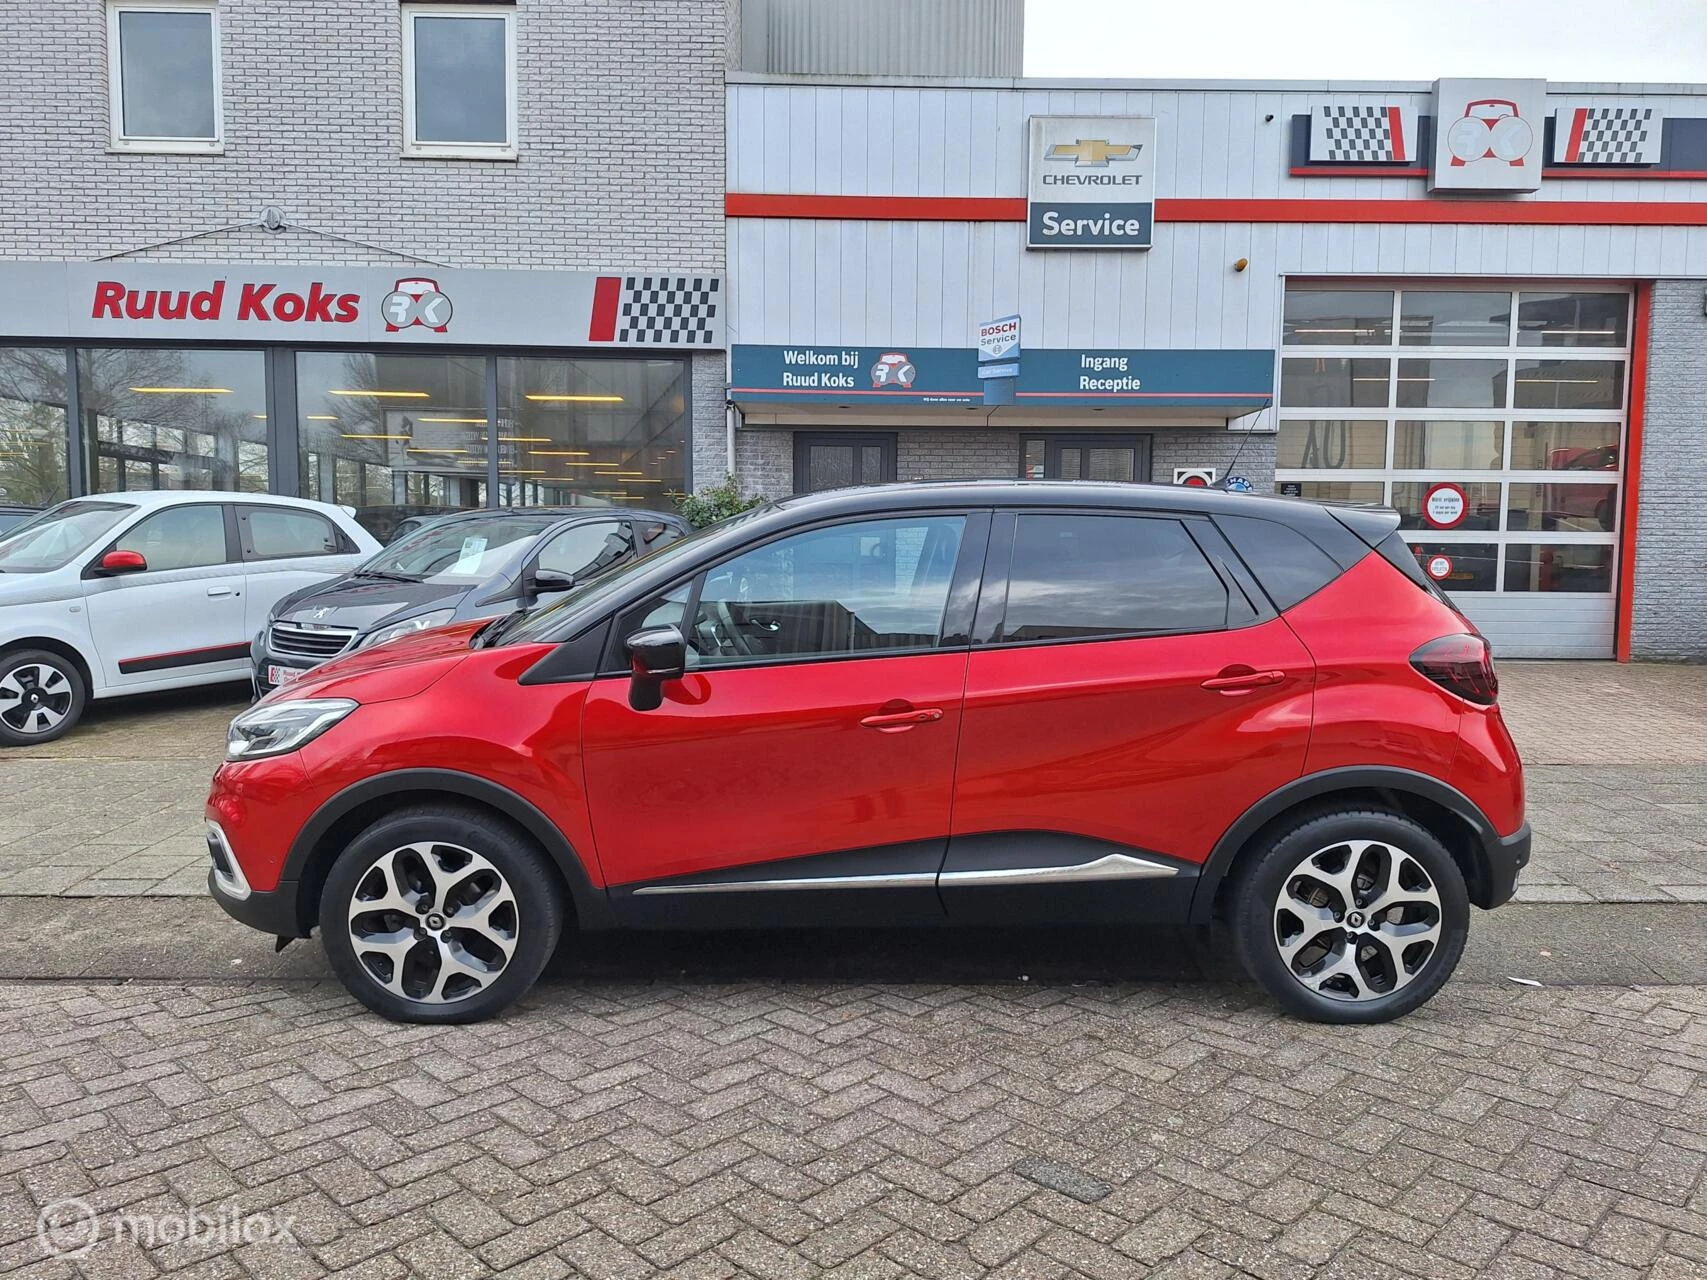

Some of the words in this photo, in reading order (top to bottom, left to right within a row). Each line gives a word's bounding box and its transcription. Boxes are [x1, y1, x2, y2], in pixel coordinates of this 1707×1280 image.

[1042, 174, 1143, 186] CHEVROLET
[1042, 211, 1140, 236] Service
[91, 280, 226, 321] Ruud
[236, 282, 361, 323] Koks
[981, 321, 1017, 337] BOSCH
[980, 334, 1017, 346] Service
[783, 350, 839, 365] Welkom
[841, 351, 859, 369] bij
[1081, 354, 1129, 371] Ingang
[783, 372, 818, 387] Ruud
[821, 373, 855, 388] Koks
[1079, 376, 1141, 392] Receptie
